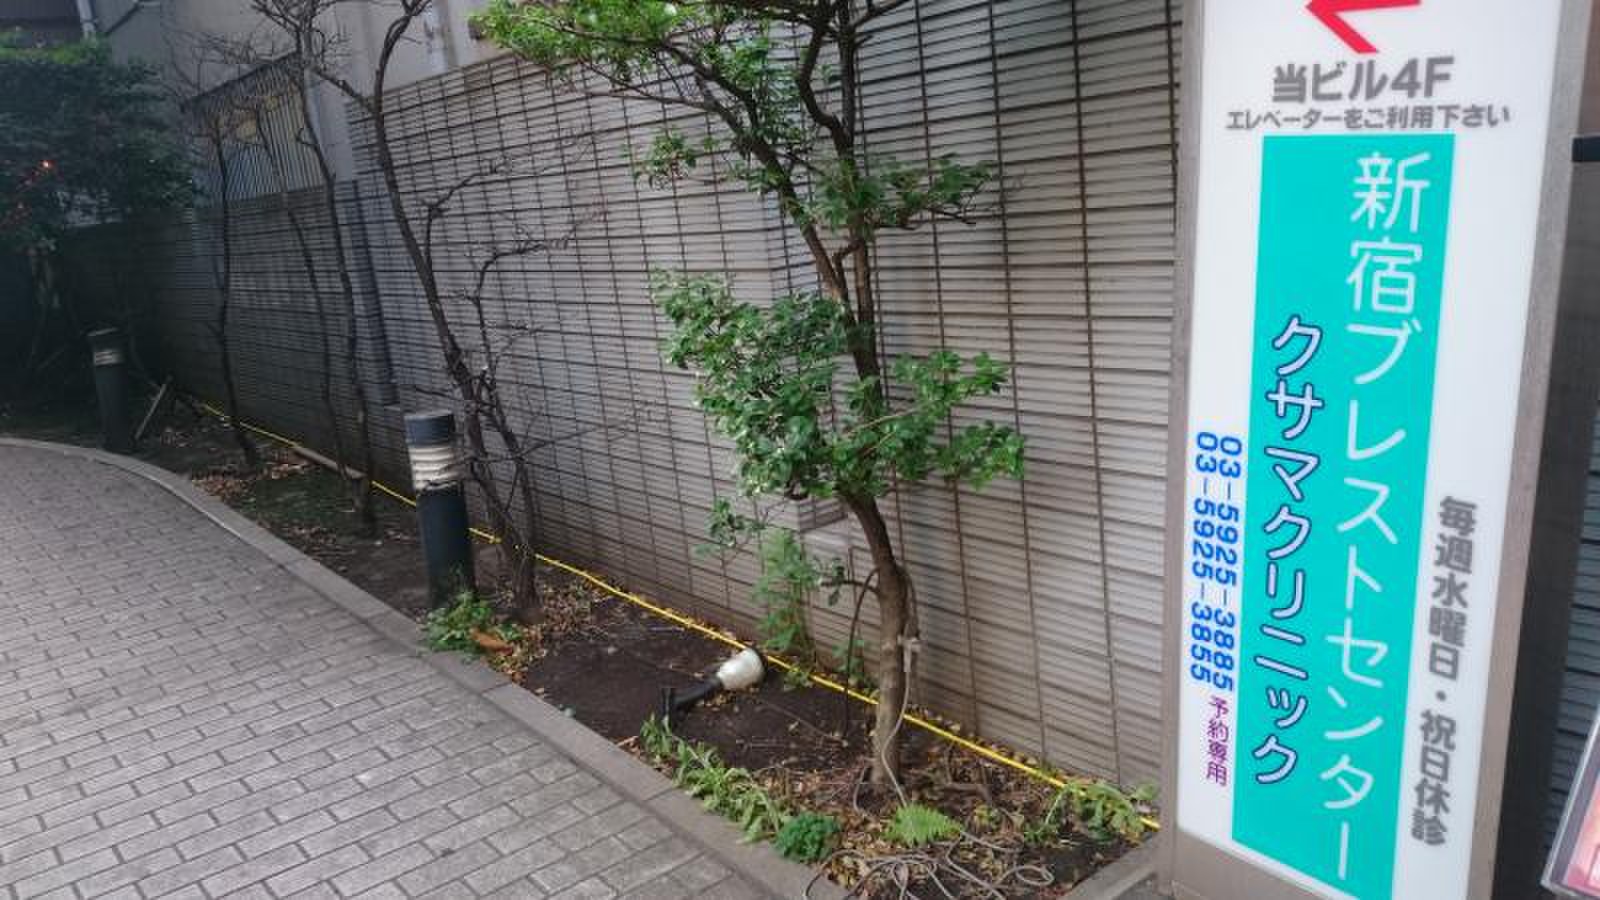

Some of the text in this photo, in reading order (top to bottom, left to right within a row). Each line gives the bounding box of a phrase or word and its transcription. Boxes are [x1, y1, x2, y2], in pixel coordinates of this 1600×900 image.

[1225, 104, 1511, 130] エレベーターをご利用下さい
[1271, 55, 1454, 103] 当ビル4F
[1189, 431, 1218, 683] 03-5925-3855
[1206, 436, 1242, 787] 03-5925-3885 予約専用
[1252, 315, 1324, 784] クサマクリニック
[1320, 151, 1431, 880] 新宿ブレストセンター
[1411, 496, 1477, 846] 毎週水曜日・祝日休診
